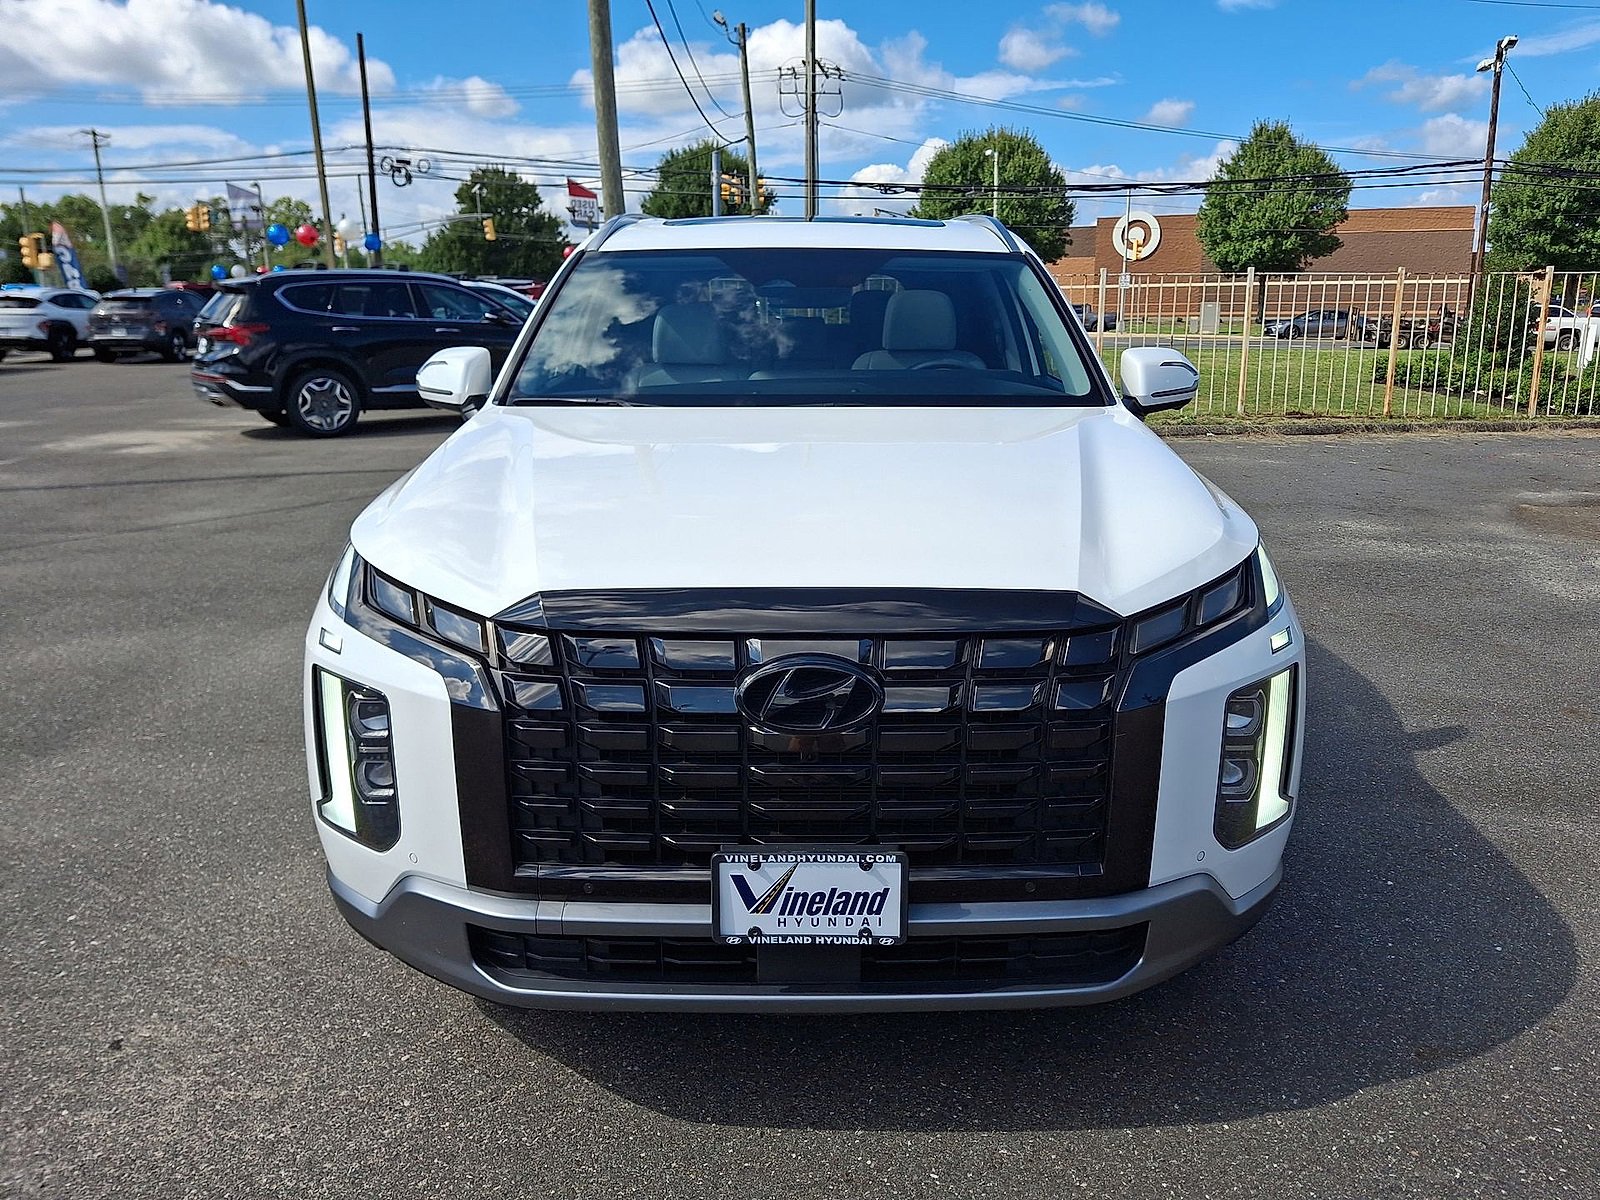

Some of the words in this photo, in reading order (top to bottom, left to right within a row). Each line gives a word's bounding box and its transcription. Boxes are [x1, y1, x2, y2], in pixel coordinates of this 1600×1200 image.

[724, 854, 897, 863] VINELANDHYUNDAI.COM
[729, 862, 891, 916] Vineland
[777, 917, 882, 928] HYUNDAI
[748, 936, 811, 944] VINELAND
[815, 937, 873, 945] HYUNDAI
